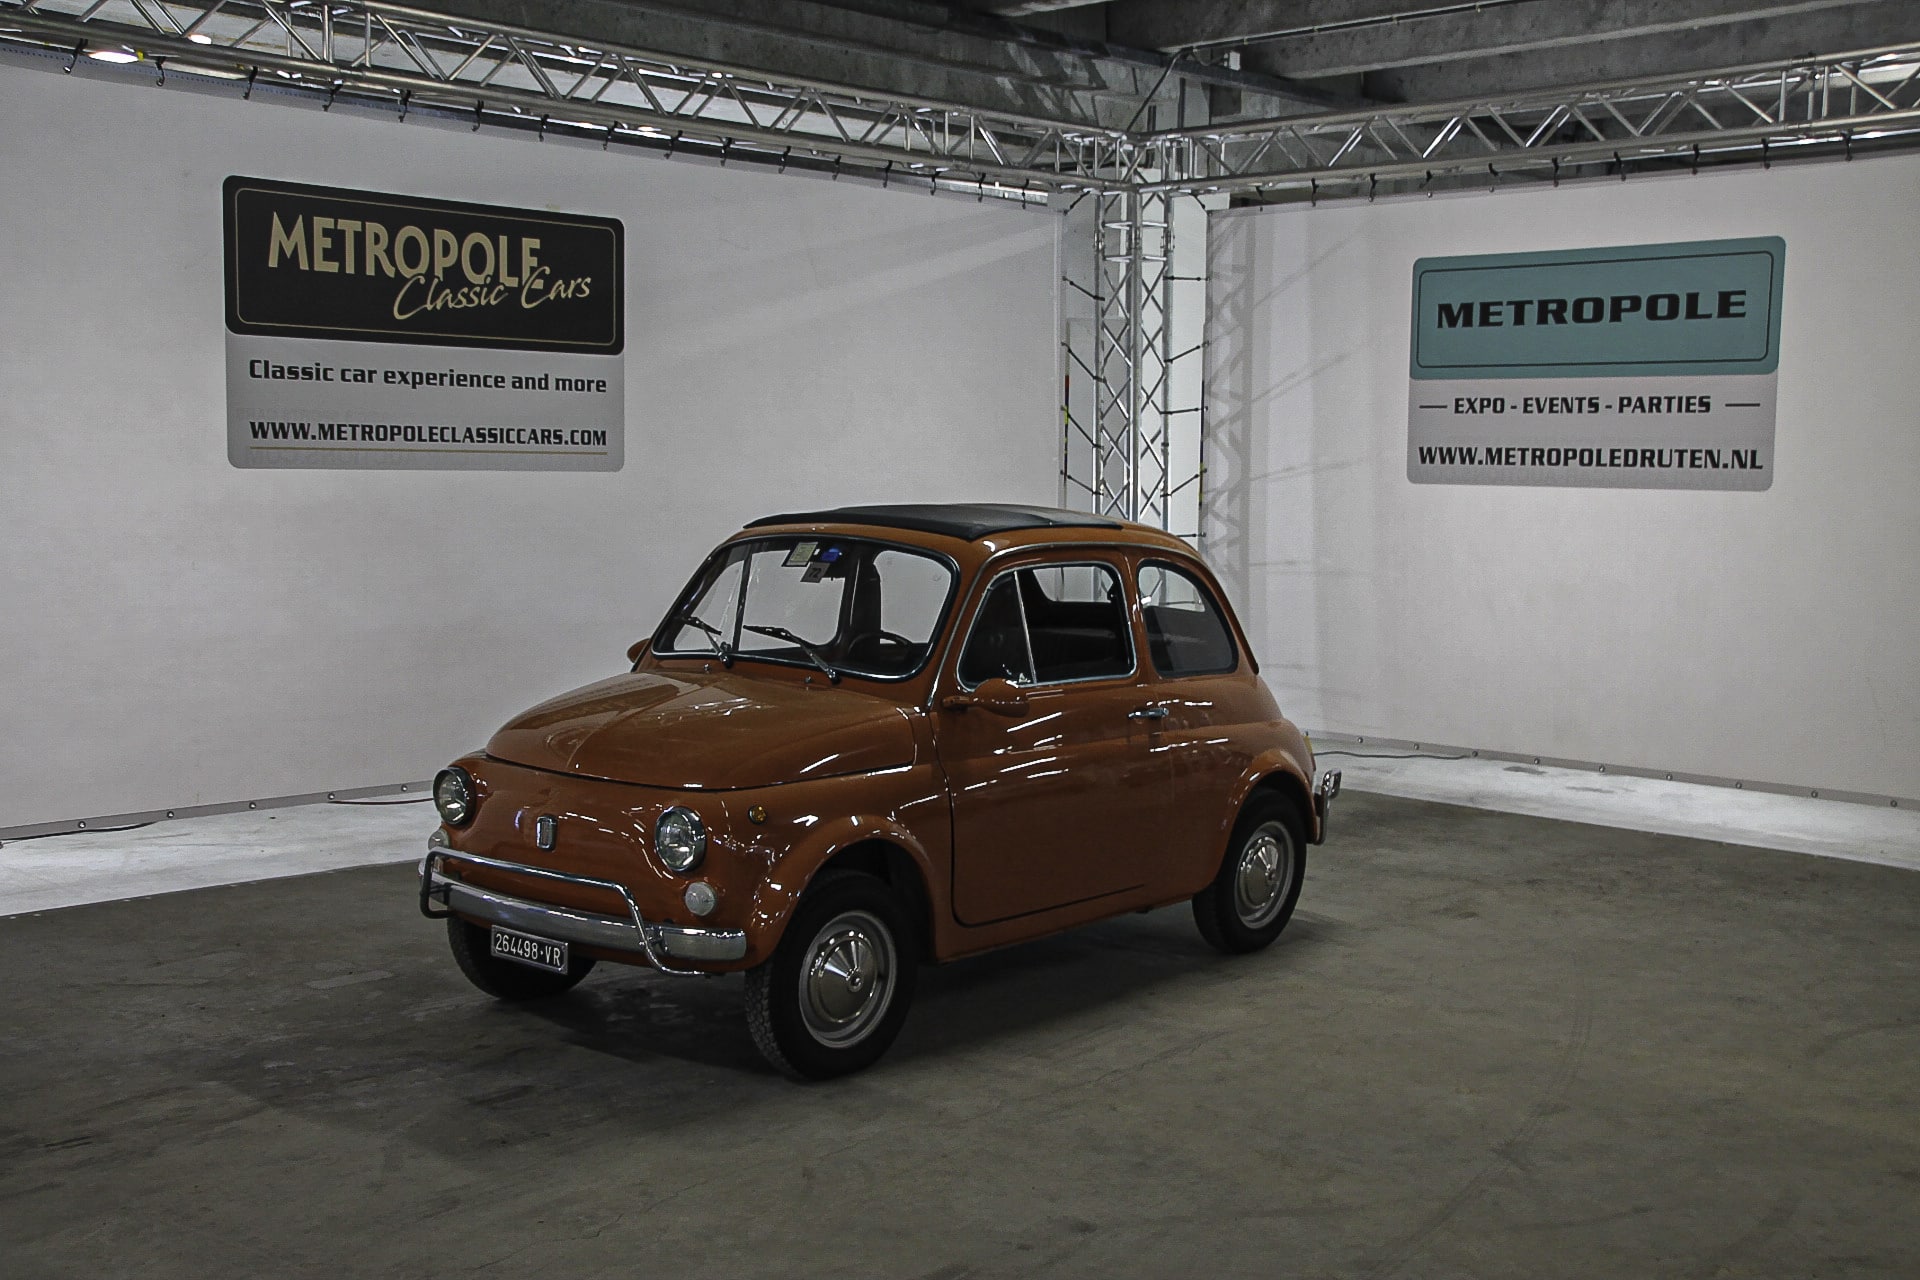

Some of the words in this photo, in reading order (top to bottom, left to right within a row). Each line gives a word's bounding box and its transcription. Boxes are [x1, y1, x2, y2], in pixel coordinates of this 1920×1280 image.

[268, 211, 544, 289] METROPOLE
[393, 275, 508, 320] Classic
[521, 266, 591, 309] Cars
[1437, 289, 1747, 329] METROPOLE
[249, 359, 335, 382] Classic
[340, 368, 378, 384] car
[383, 368, 506, 390] experience
[511, 373, 550, 391] and
[554, 377, 607, 393] more
[1453, 397, 1505, 415] EXPO
[1522, 396, 1600, 414] EVENTS
[1618, 395, 1711, 414] PARTIES
[249, 420, 607, 446] WWW.METROPOLECLASSICCARS.COM
[1418, 446, 1764, 470] WWW.METROPOLEDRUTEN.NL
